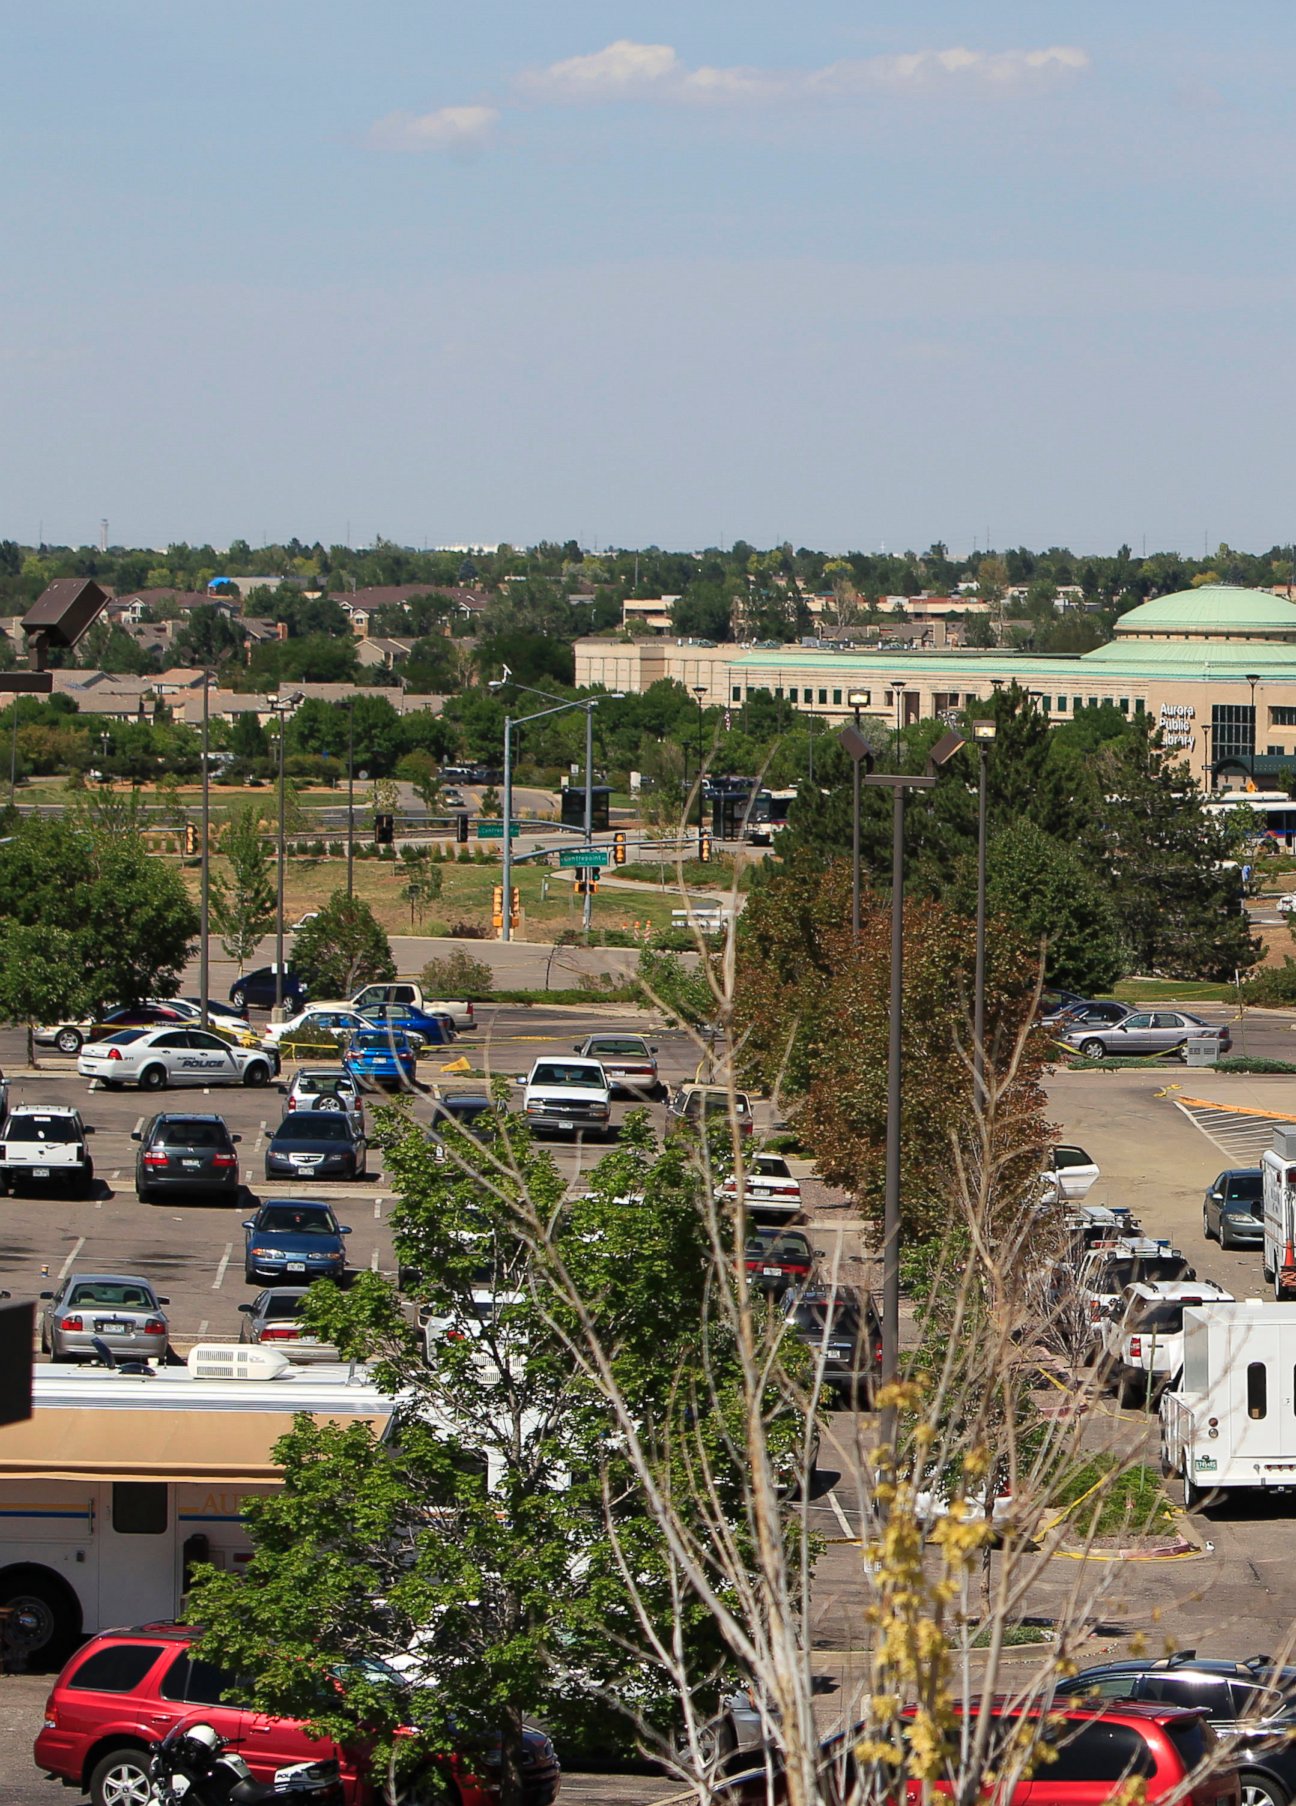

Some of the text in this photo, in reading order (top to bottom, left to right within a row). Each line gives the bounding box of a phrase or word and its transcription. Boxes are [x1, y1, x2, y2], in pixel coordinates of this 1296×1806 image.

[1160, 703, 1194, 716] Aurora
[1160, 717, 1190, 731] Public
[182, 1060, 225, 1068] POLICE
